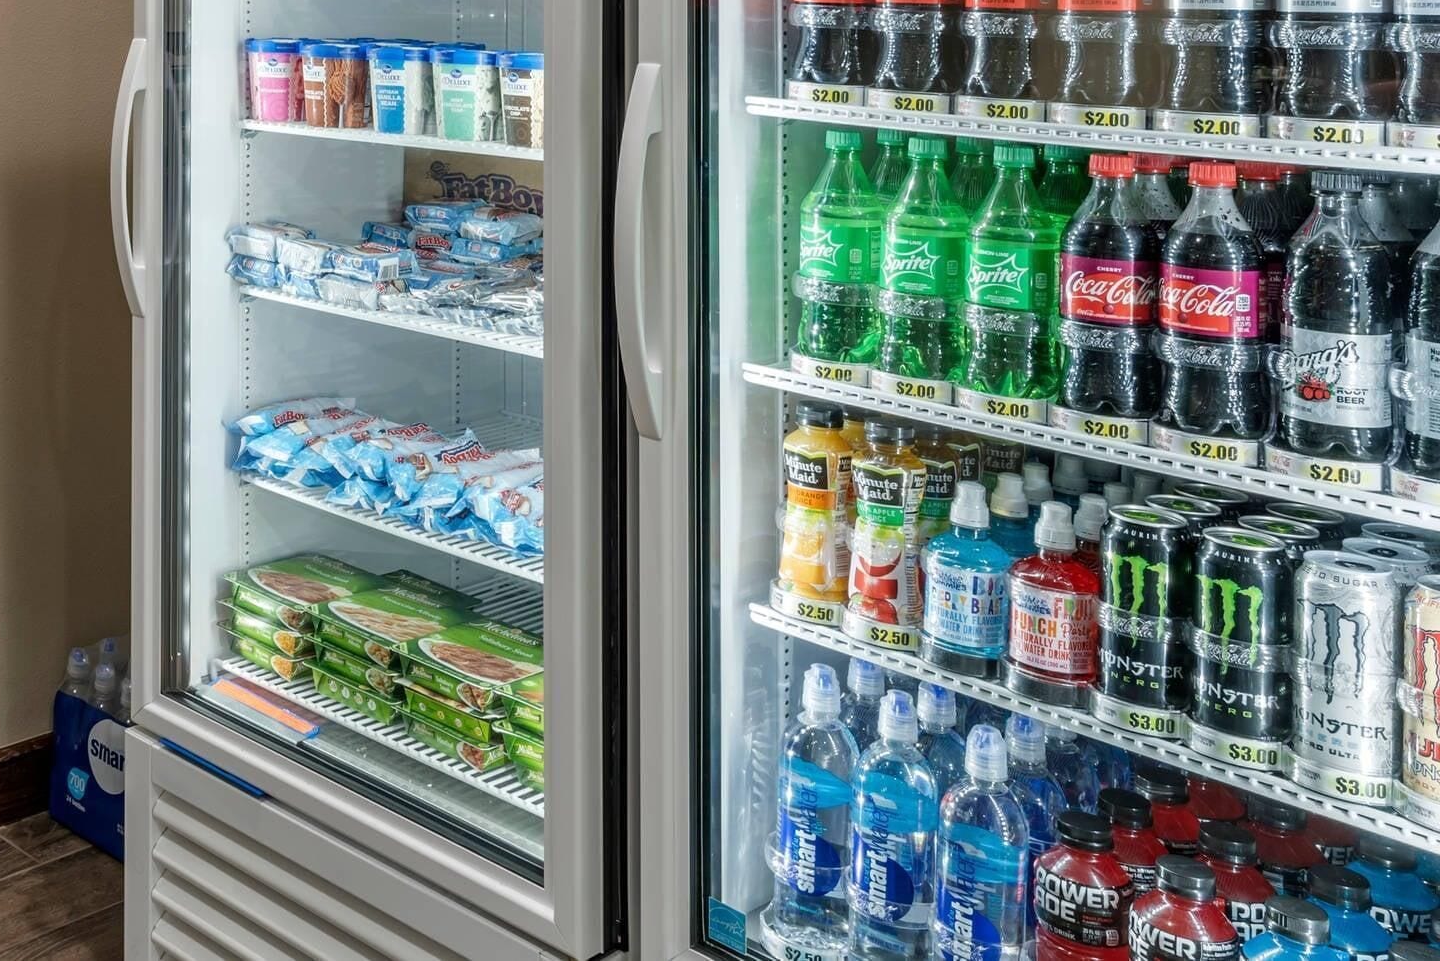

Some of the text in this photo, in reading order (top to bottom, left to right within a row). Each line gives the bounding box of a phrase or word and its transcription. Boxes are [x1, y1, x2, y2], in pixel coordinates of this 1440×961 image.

[812, 89, 849, 103] $2.00
[894, 96, 933, 112] $2.00
[987, 104, 1028, 120] $2.00
[1085, 111, 1129, 127] $2.00
[1194, 120, 1240, 136] $2.00
[1313, 126, 1364, 144] $2.00
[800, 242, 833, 259] Sprite
[885, 254, 930, 274] Sprite
[1097, 265, 1123, 273] CHERRY
[969, 267, 1018, 285] Sprite
[1067, 270, 1155, 306] Coca-Cola
[1159, 278, 1241, 317] Coca-Cola
[815, 366, 852, 382] $2.00
[896, 382, 935, 399] $2.00
[988, 400, 1029, 418] $2.00
[1337, 396, 1365, 405] BEER
[274, 411, 305, 425] FatBoy
[1084, 420, 1129, 439] $2.00
[1190, 441, 1238, 461] $2.00
[785, 454, 822, 474] Minute
[853, 471, 898, 490] Minute
[926, 473, 953, 483] nute
[1310, 464, 1361, 485] $2.00
[874, 508, 896, 516] APPLE
[1214, 551, 1258, 565] AURINE
[1332, 575, 1378, 588] SUGAR
[797, 602, 834, 622] $2.50
[870, 627, 910, 646] $2.50
[1024, 644, 1070, 661] WATER DRINK
[1098, 647, 1184, 679] MONSTER
[1108, 671, 1170, 690] NERGY
[1129, 712, 1175, 734] $3.00
[1293, 707, 1388, 741] MONSTER
[90, 737, 126, 772] smar
[1229, 743, 1277, 766] $3.00
[1329, 748, 1361, 760] ULTRA
[70, 771, 86, 792] 700
[1335, 777, 1386, 800] $3.00
[1036, 867, 1120, 910] POWER
[1035, 885, 1076, 923] ADE
[1369, 905, 1432, 934] OWE
[1055, 928, 1076, 940] DRINK
